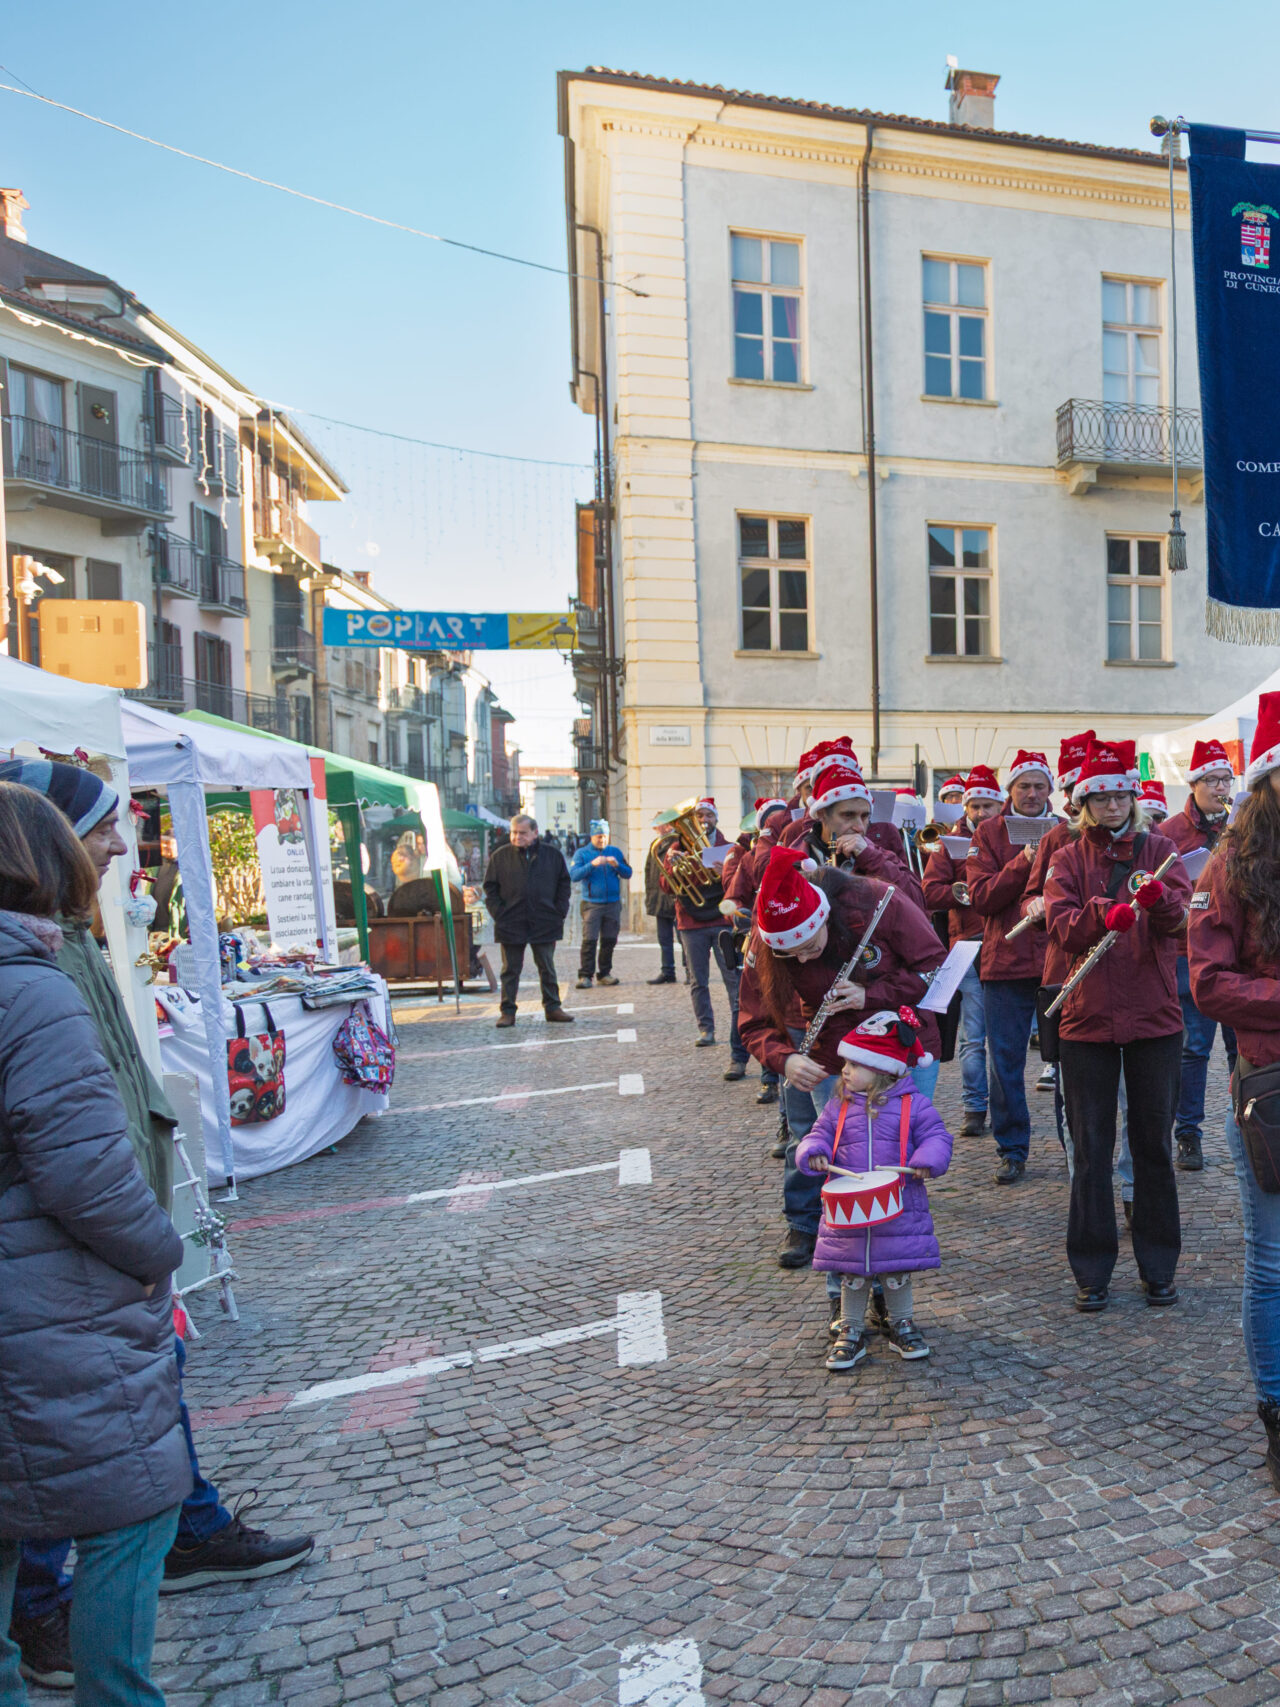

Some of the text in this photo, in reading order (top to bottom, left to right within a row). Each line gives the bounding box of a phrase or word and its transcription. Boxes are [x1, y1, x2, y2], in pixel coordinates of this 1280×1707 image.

[1226, 280, 1238, 290] DI
[278, 893, 292, 902] cane
[277, 912, 300, 923] Sostieni
[301, 911, 307, 920] la
